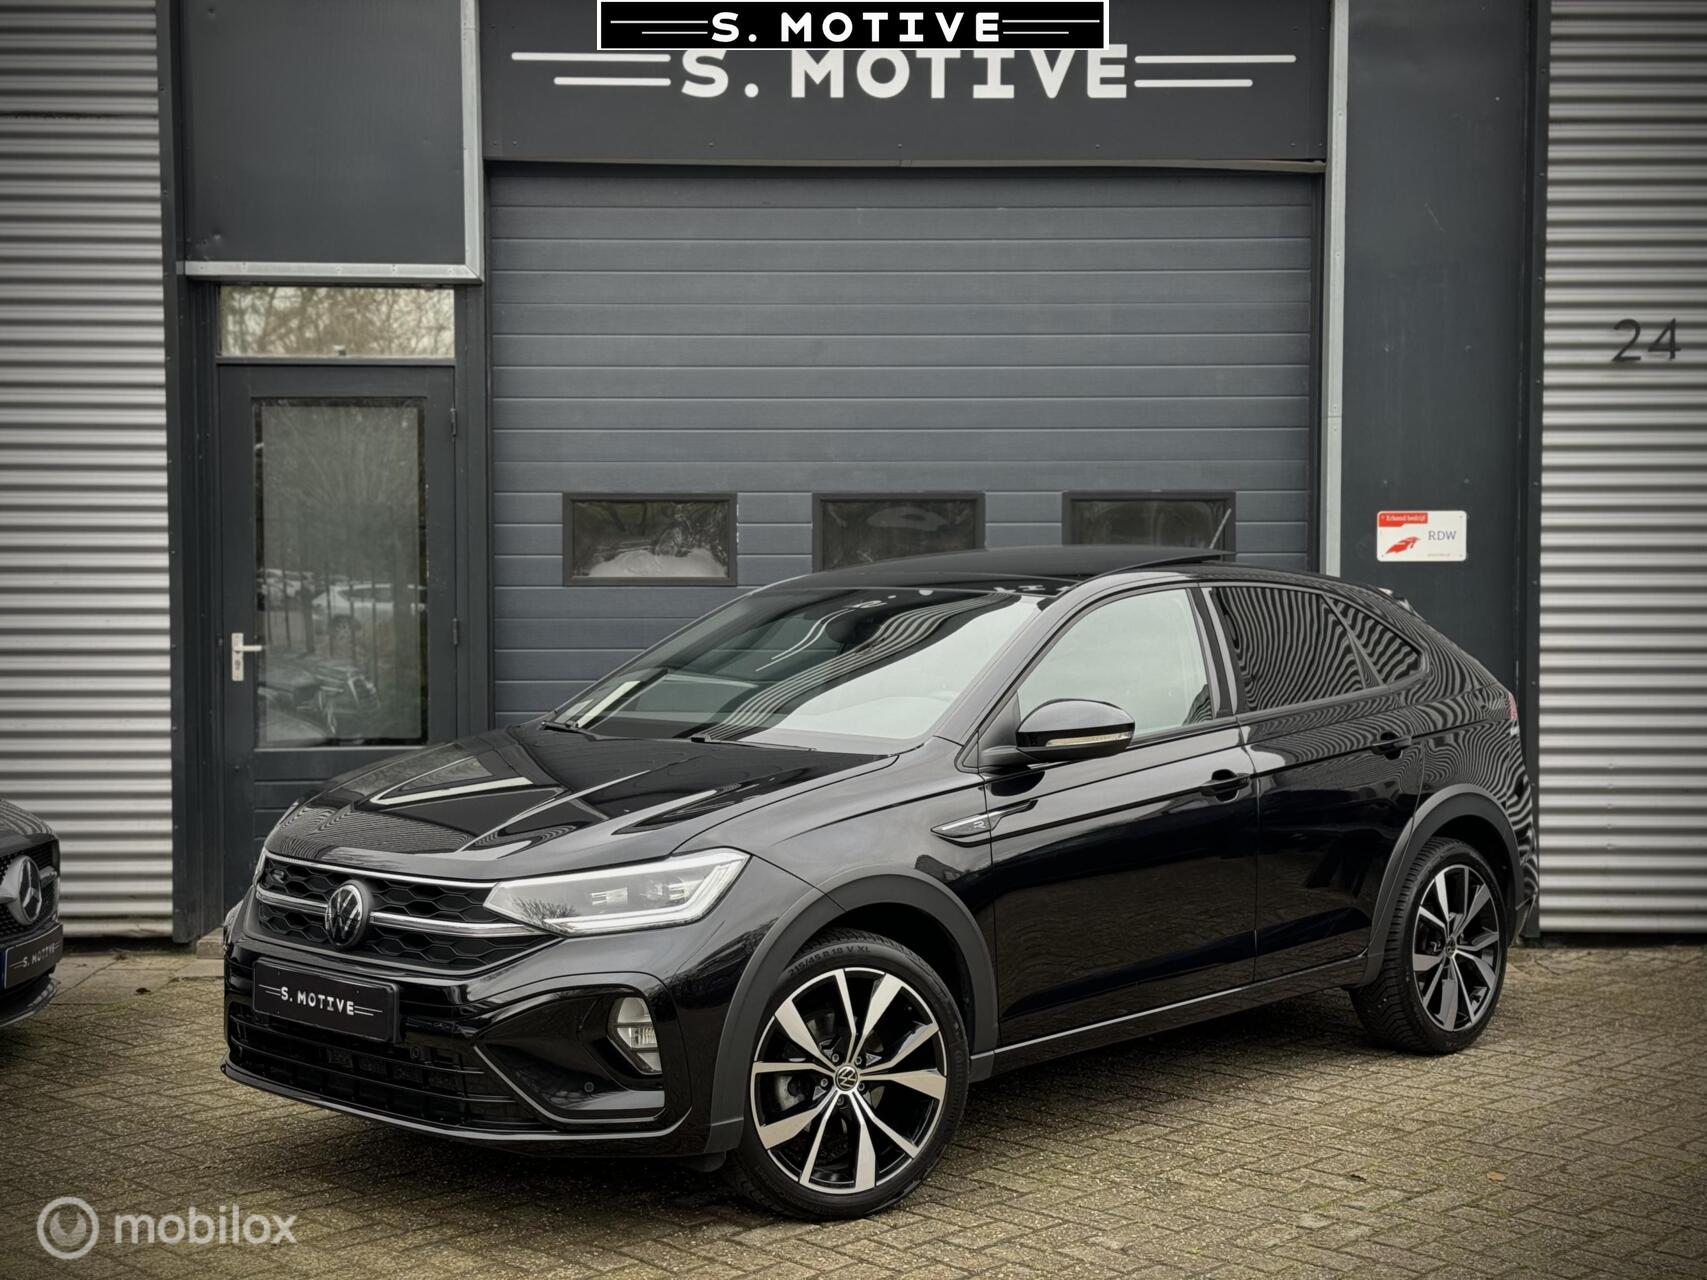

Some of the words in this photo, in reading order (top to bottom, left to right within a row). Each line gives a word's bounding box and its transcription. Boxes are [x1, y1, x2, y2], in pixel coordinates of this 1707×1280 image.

[681, 49, 759, 98] S.
[791, 44, 1128, 98] MOTIVE
[1612, 317, 1682, 361] 24
[1428, 530, 1457, 541] RDW
[280, 986, 293, 1002] S.
[297, 990, 355, 1015] MOTIVE
